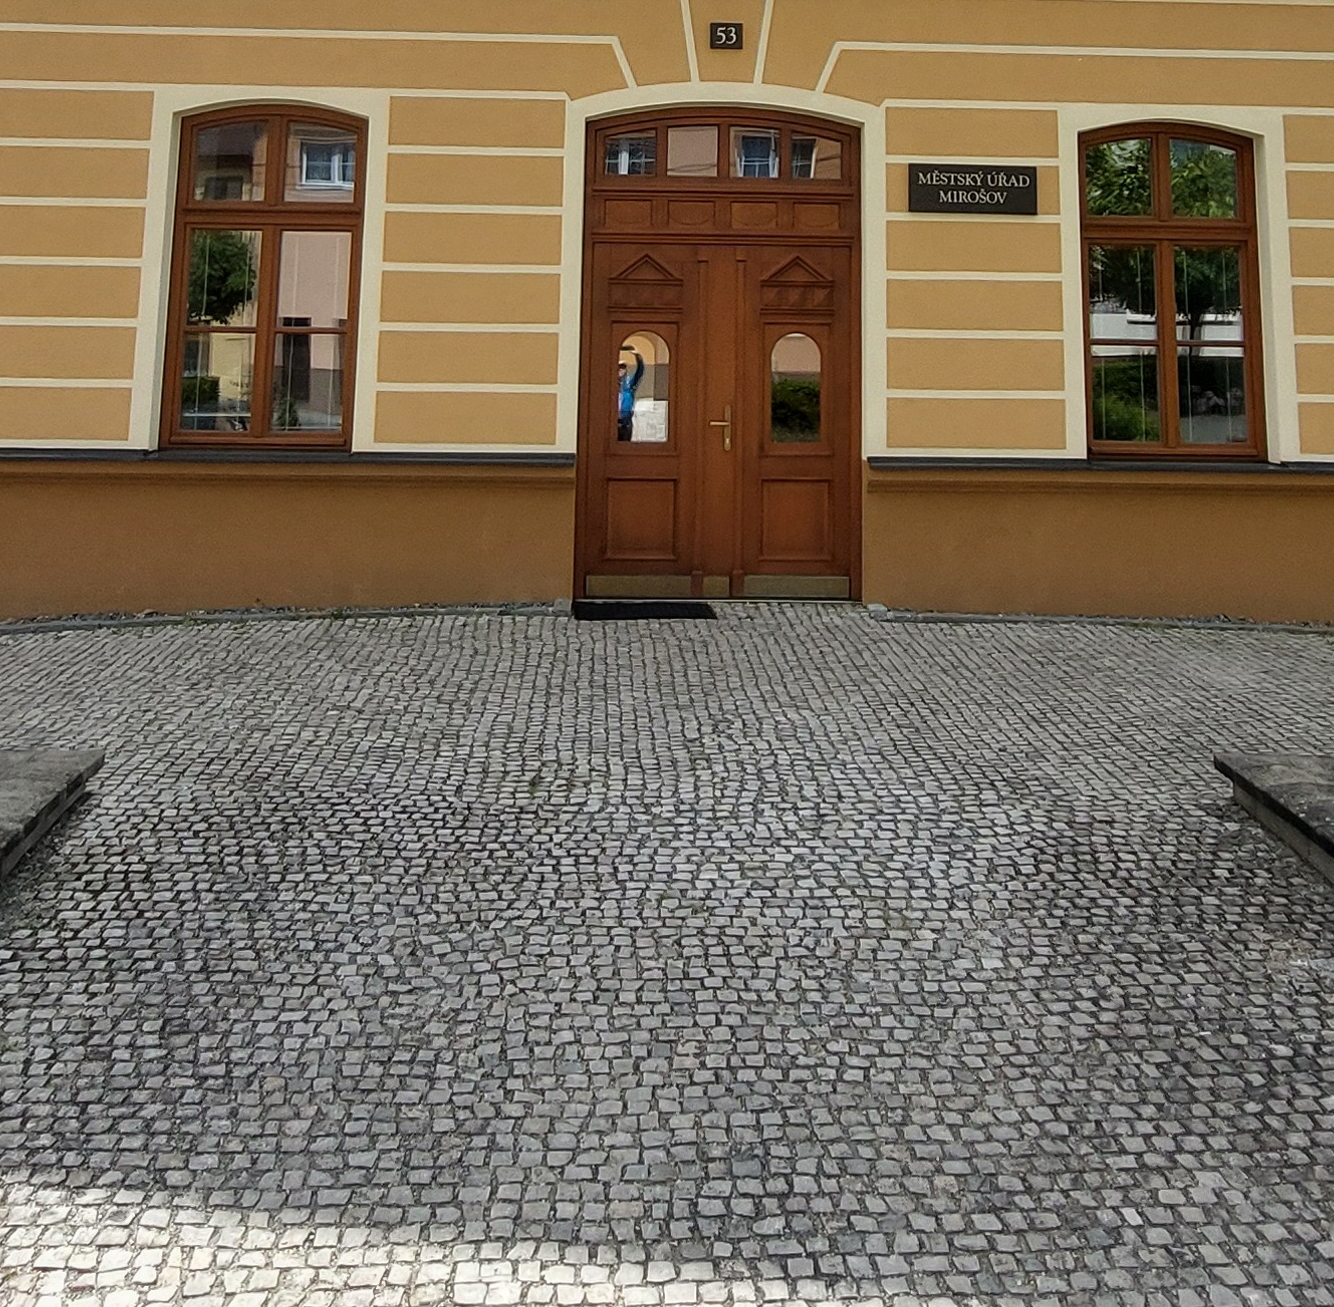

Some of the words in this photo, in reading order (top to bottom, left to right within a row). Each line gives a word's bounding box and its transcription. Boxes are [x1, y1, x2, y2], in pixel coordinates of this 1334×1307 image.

[715, 27, 737, 44] 53
[917, 170, 984, 187] MĚSTSKÝ
[987, 171, 1030, 188] ÚŘAD
[939, 188, 1007, 204] MIROŠOV
